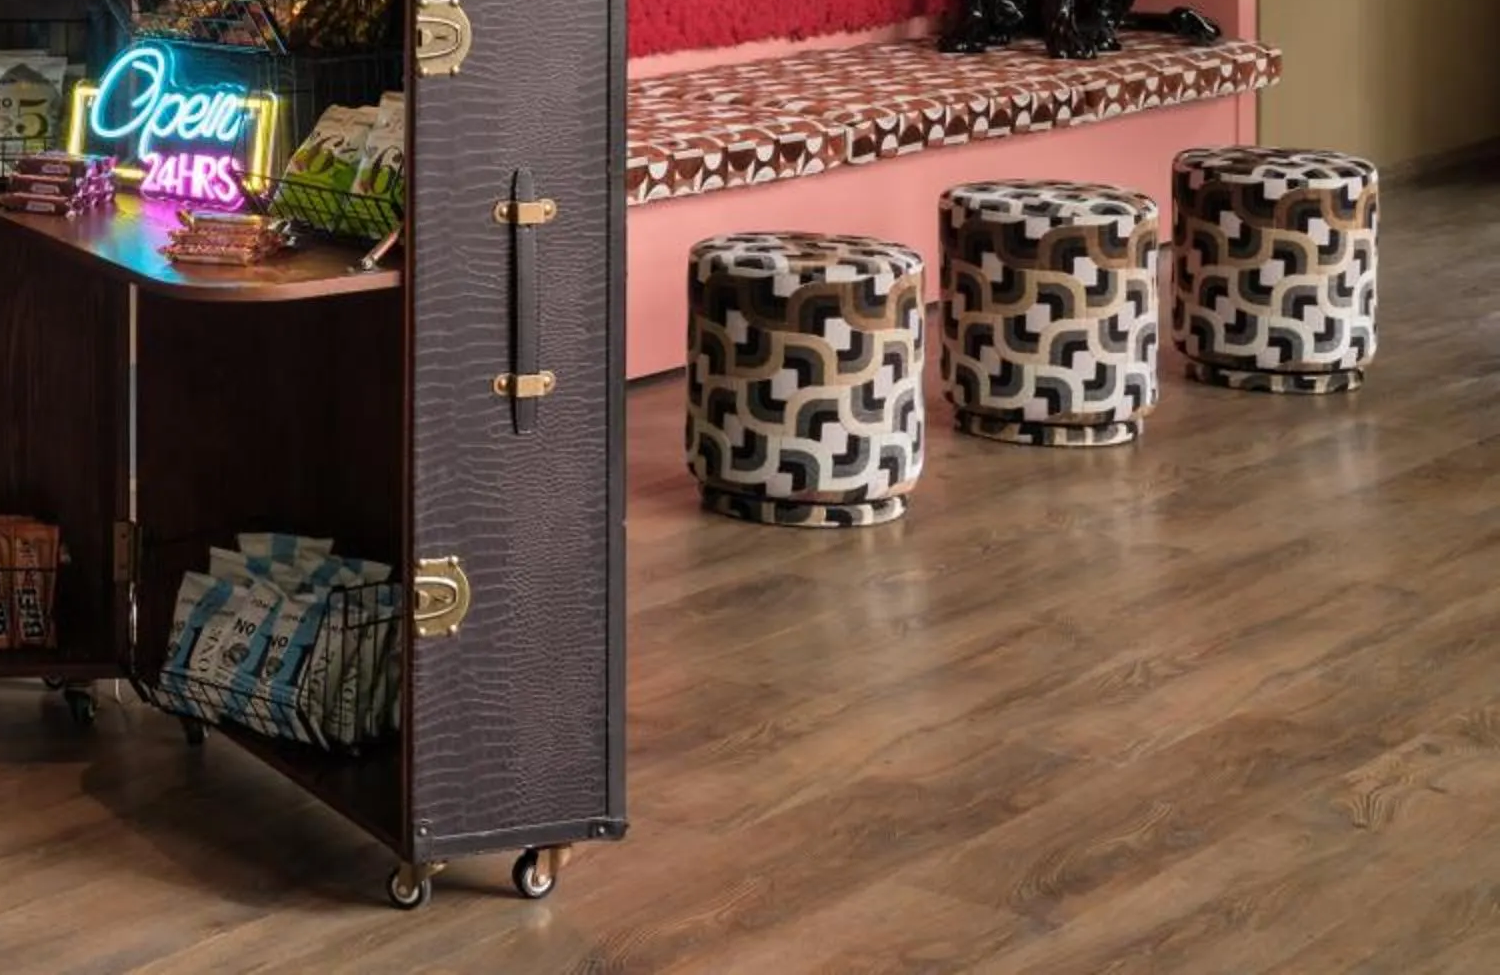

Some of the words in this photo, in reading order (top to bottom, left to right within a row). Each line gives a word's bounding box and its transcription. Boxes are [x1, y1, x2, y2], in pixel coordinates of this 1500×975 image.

[15, 98, 49, 138] 5
[90, 47, 242, 161] Open
[140, 152, 245, 203] 24HRS
